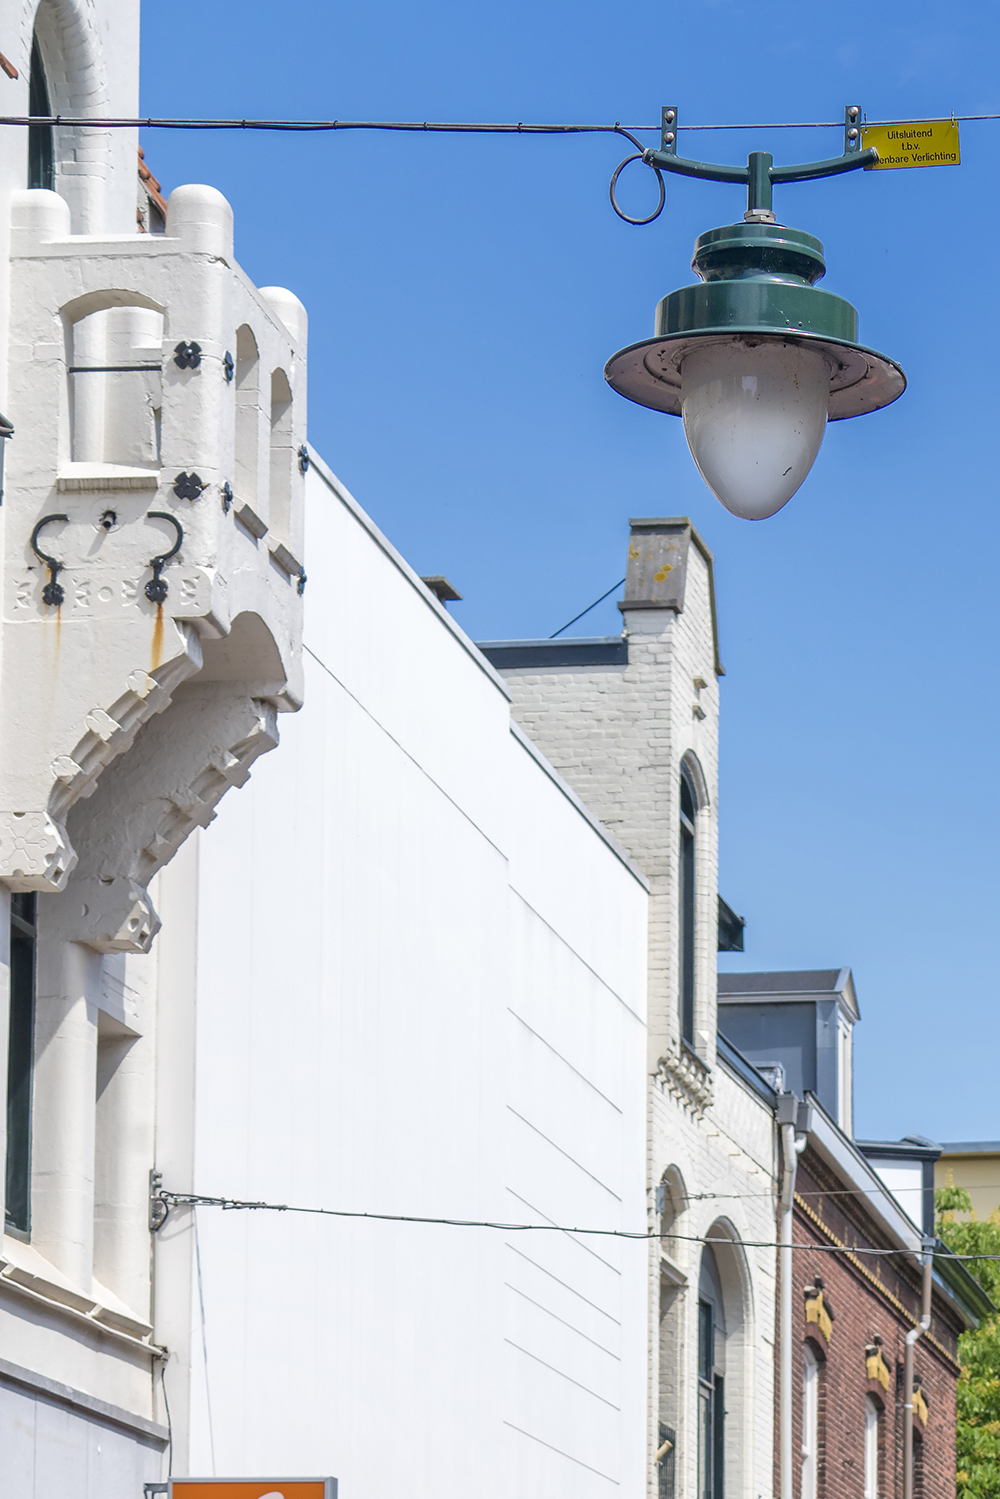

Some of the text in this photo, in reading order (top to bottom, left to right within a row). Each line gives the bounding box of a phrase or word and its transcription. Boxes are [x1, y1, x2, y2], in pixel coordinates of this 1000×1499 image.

[887, 129, 933, 140] Uitsluitend
[901, 142, 920, 151] t.b.v.
[874, 152, 957, 166] penbare Verlichting
